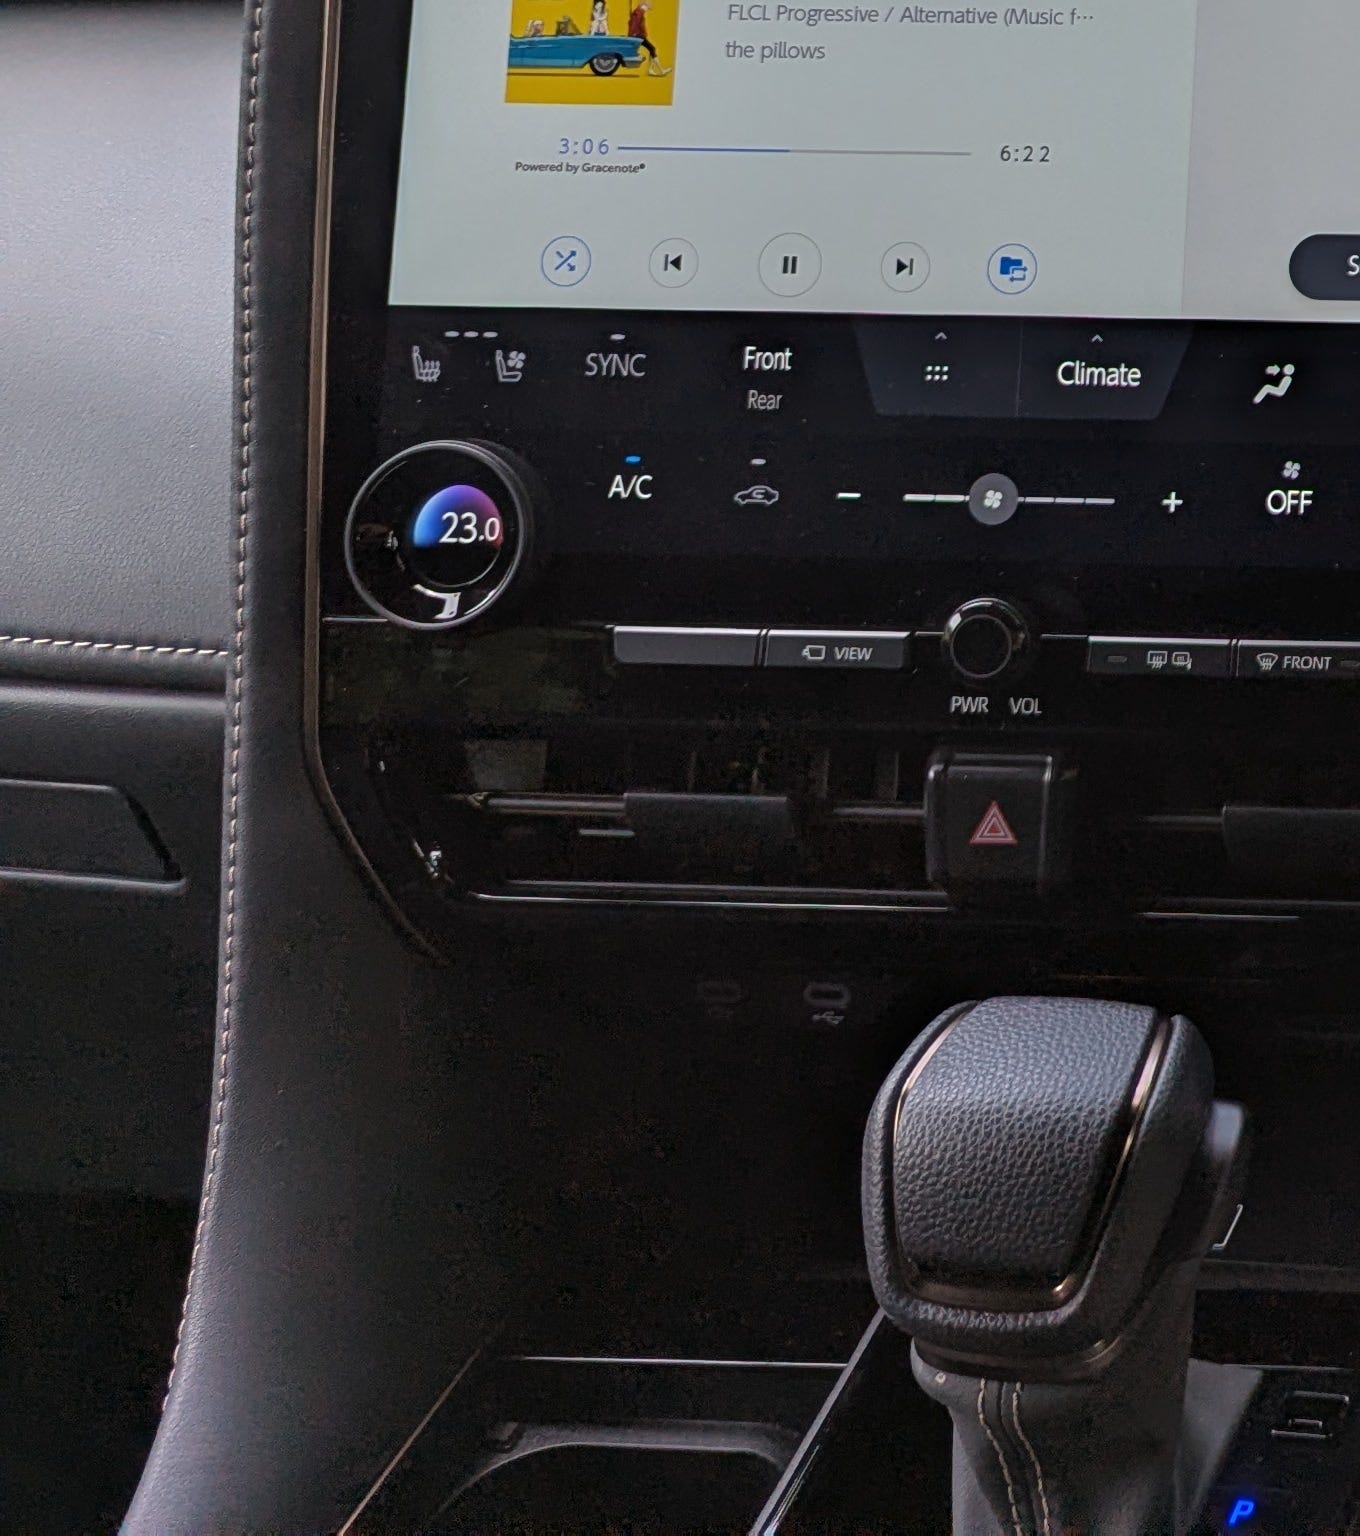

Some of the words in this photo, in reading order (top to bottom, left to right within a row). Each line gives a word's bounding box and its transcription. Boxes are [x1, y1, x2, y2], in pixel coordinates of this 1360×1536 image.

[728, 4, 771, 22] FLCL
[776, 5, 880, 27] Progressive
[900, 6, 998, 25] Alternative
[1004, 7, 1064, 27] (Music
[725, 41, 755, 59] the
[760, 42, 826, 64] pillows
[559, 138, 609, 155] 3:06
[999, 144, 1052, 163] 6:22
[515, 161, 563, 173] Powered
[566, 163, 581, 175] by
[585, 353, 646, 377] SYNC
[743, 346, 793, 372] Front
[1057, 361, 1142, 387] Climate
[748, 390, 782, 411] Rear
[608, 475, 653, 499] A/C
[1266, 490, 1313, 515] OFF
[439, 512, 501, 544] 23.0
[834, 646, 873, 660] VIEW
[1282, 656, 1332, 670] FRONT
[950, 696, 989, 713] PWR
[1010, 697, 1043, 715] VOL
[1228, 1500, 1255, 1526] P
